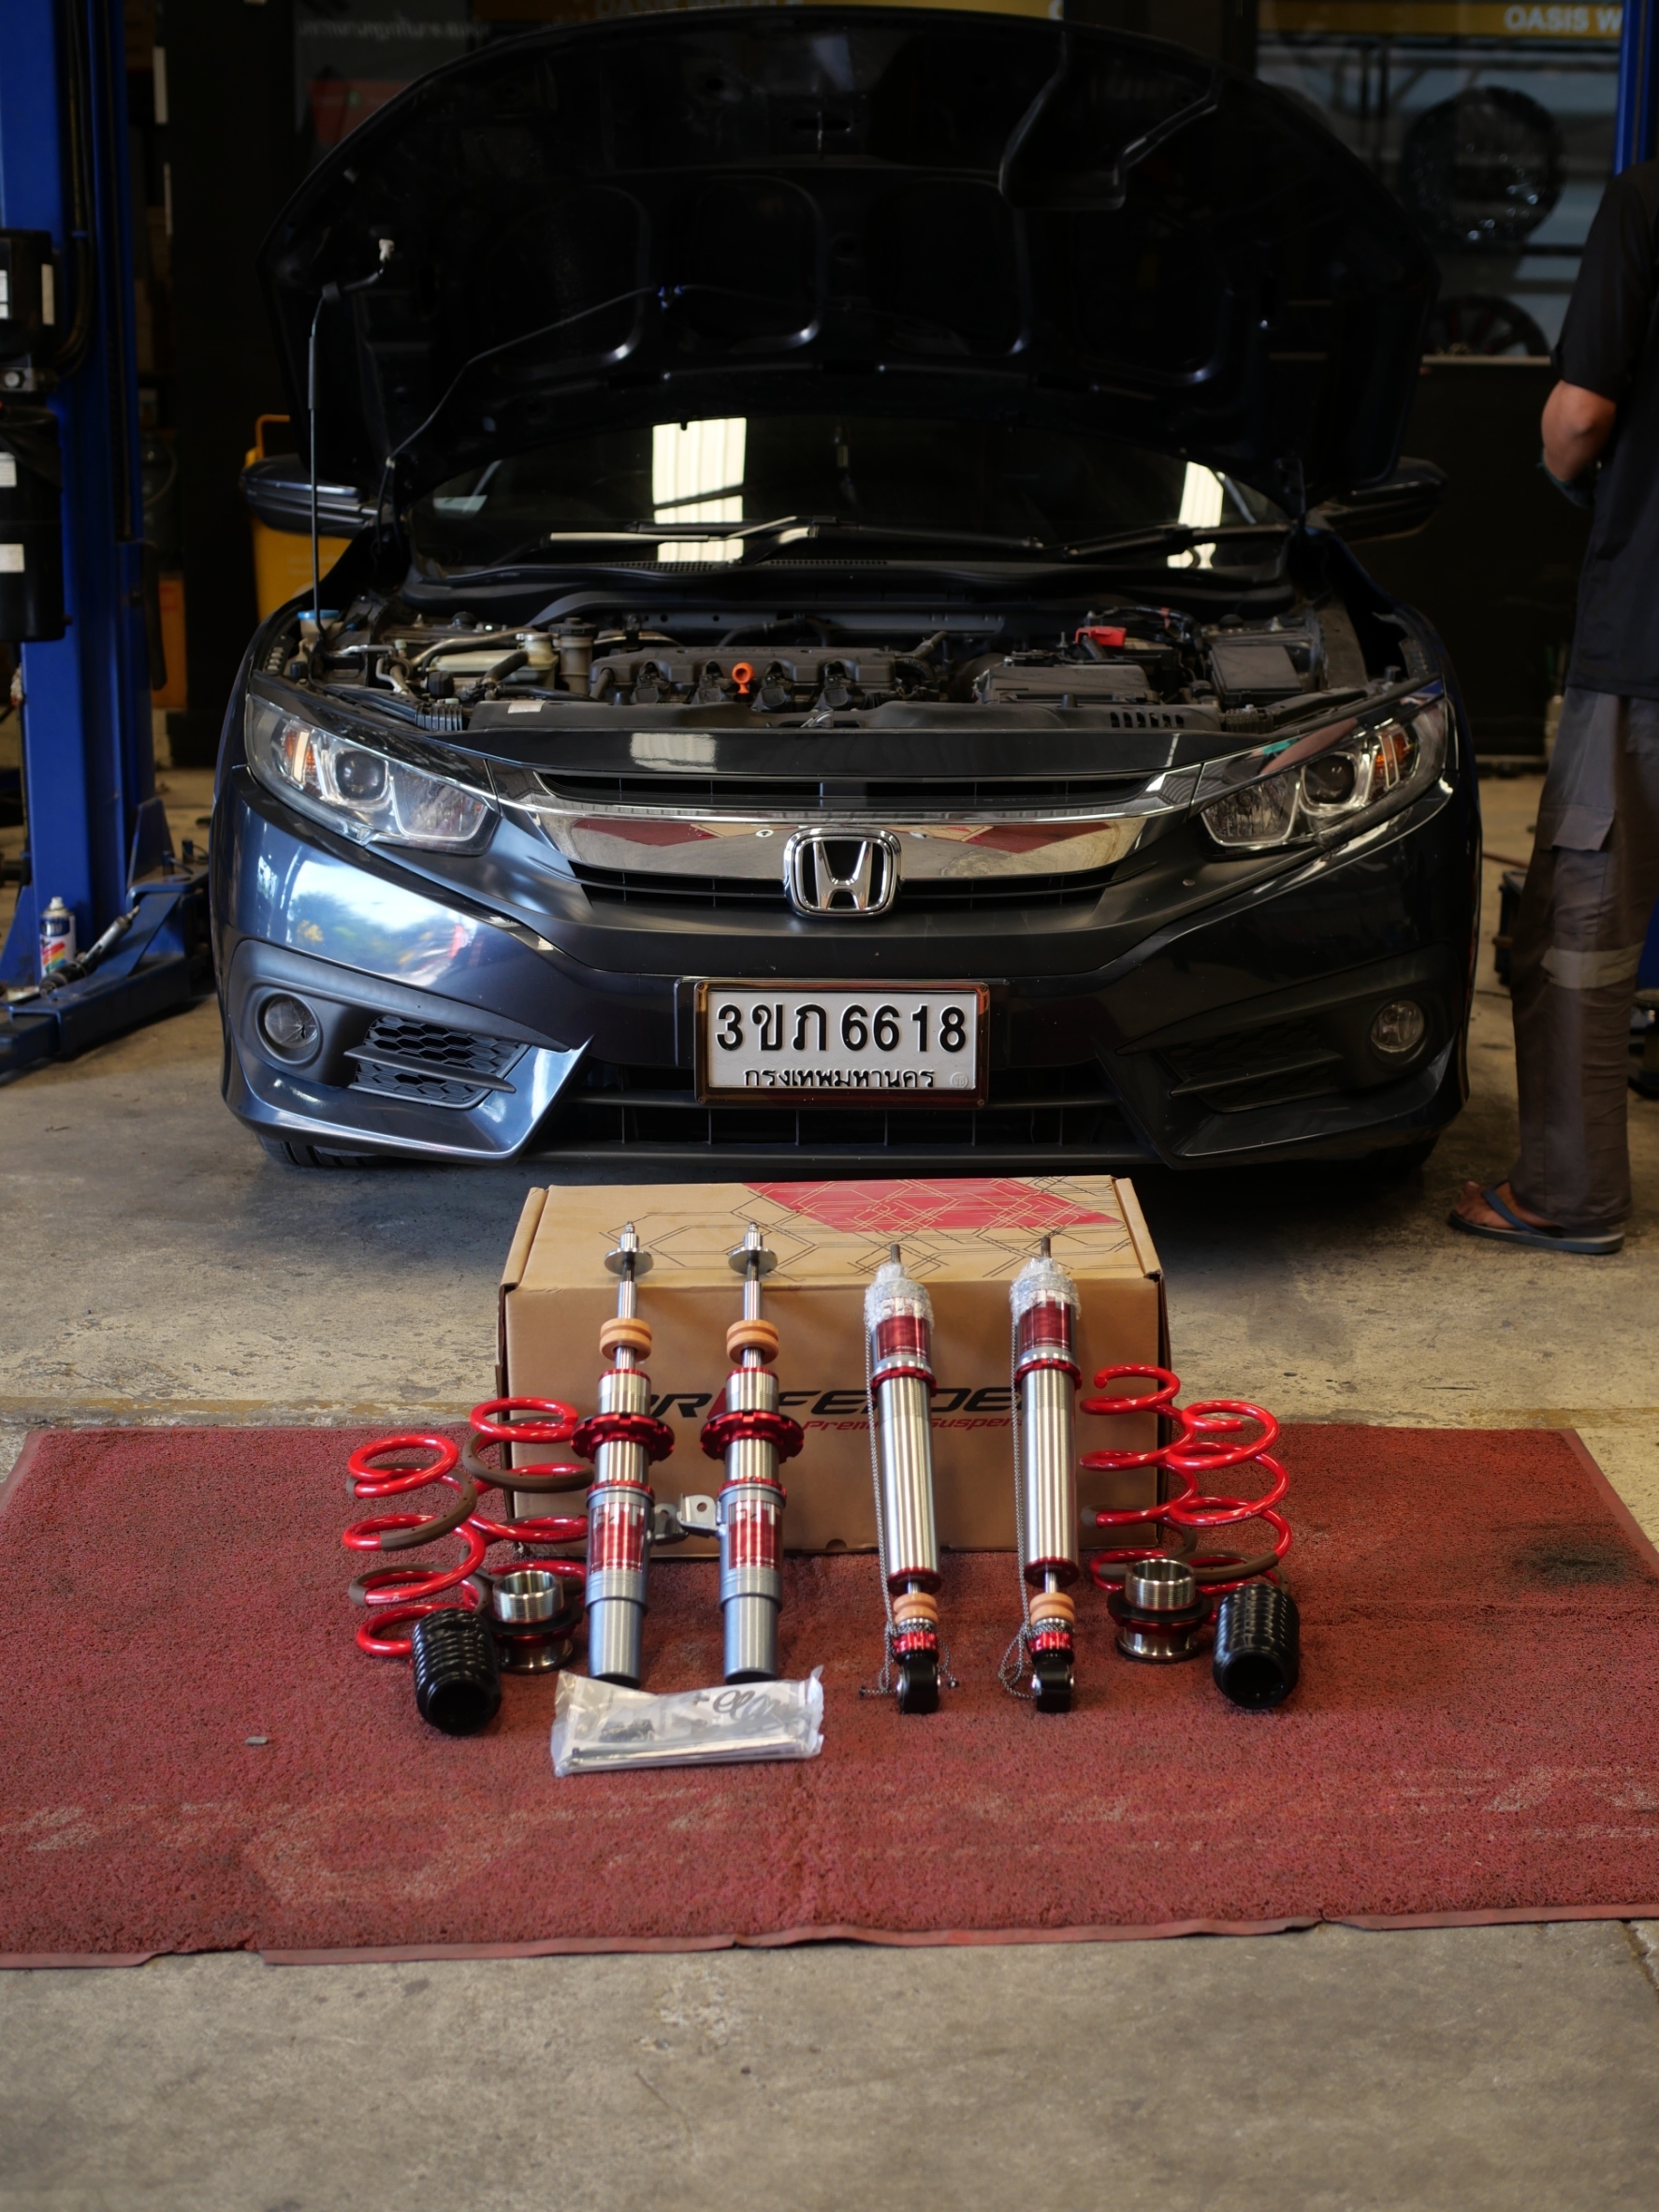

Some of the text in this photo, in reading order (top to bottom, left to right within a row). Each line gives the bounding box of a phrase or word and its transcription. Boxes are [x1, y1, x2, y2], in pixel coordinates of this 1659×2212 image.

[1504, 5, 1590, 32] OASIS
[840, 1004, 968, 1053] 6618
[744, 1069, 935, 1087] กรงเทพมหานคร
[804, 1420, 879, 1431] Prem
